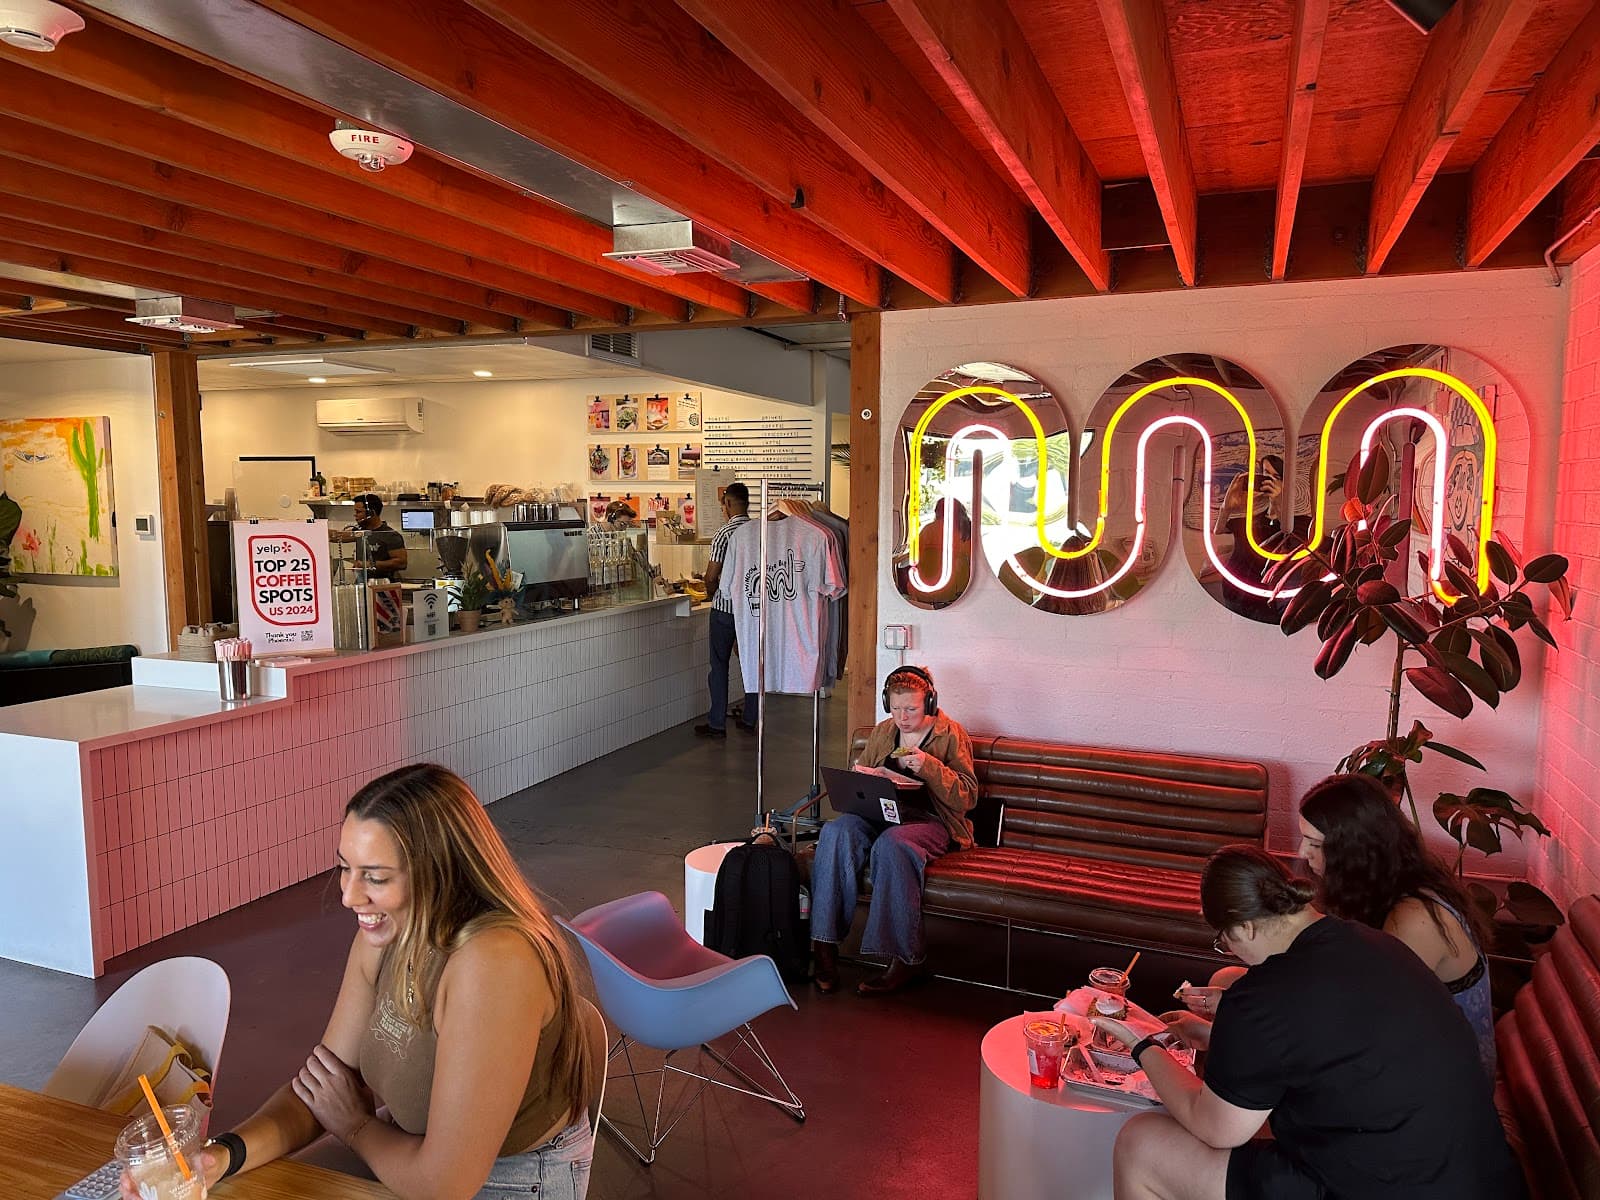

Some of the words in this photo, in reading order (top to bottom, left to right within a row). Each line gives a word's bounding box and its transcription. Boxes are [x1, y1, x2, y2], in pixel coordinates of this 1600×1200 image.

[351, 134, 380, 144] FIRE
[256, 544, 281, 555] yelp
[254, 559, 287, 573] TOP
[290, 558, 310, 572] 25
[255, 573, 311, 588] COFFEE
[259, 588, 313, 604] SPOTS
[269, 607, 284, 616] US
[285, 605, 314, 615] 2024
